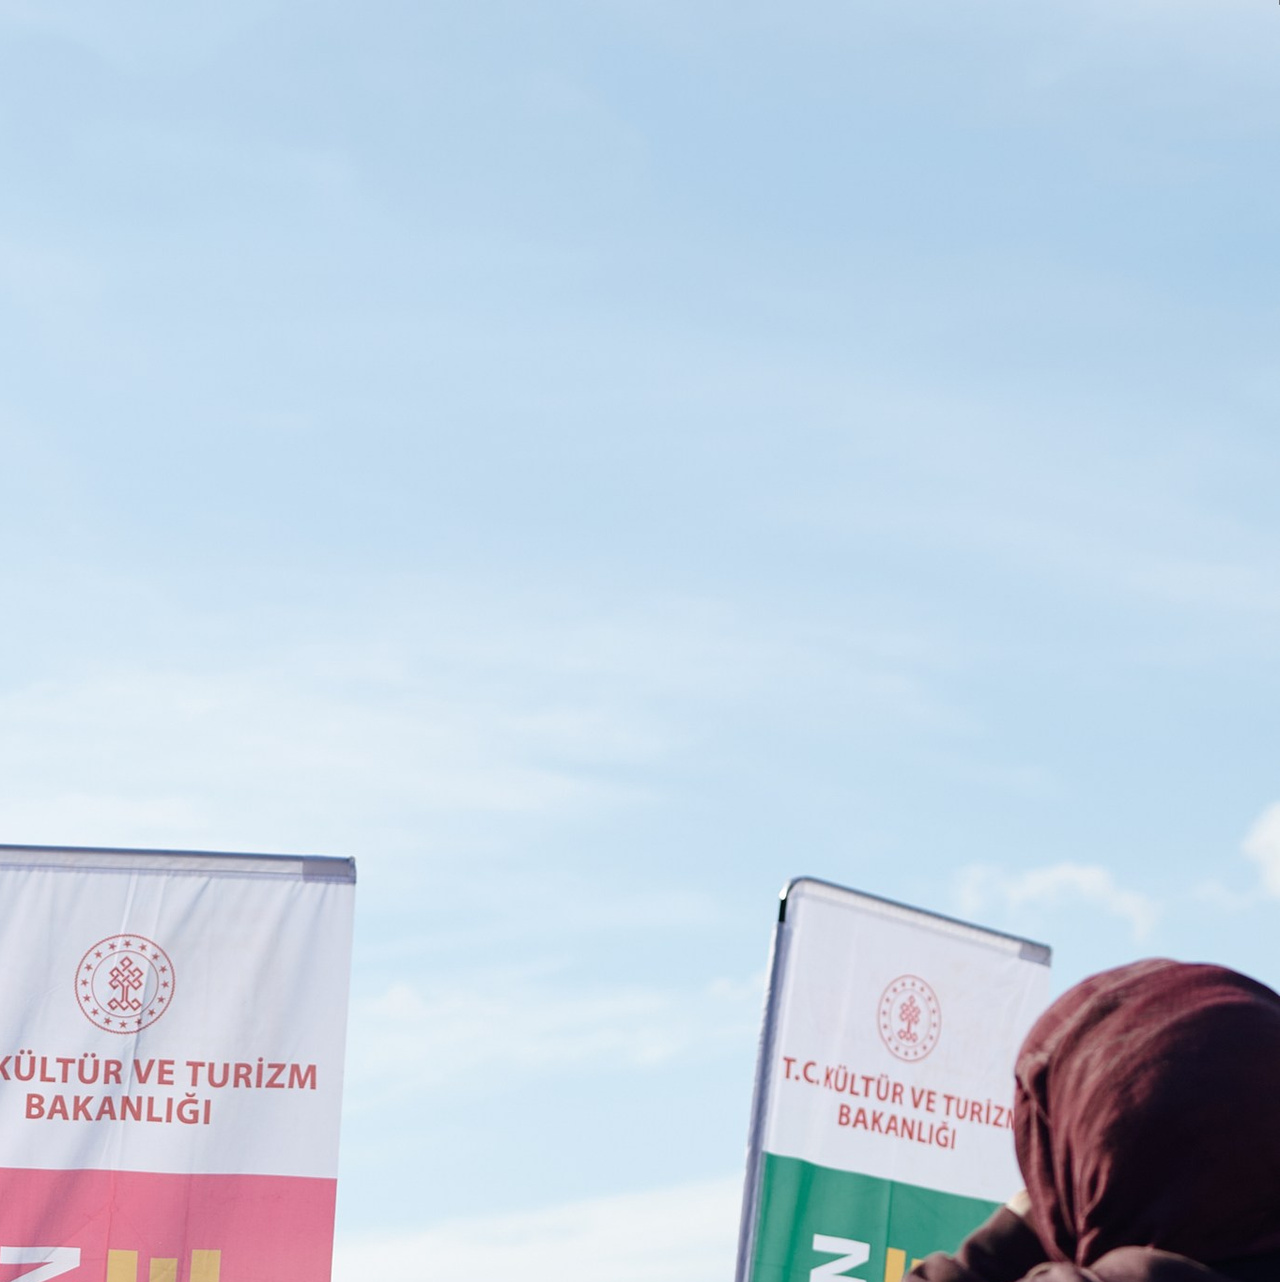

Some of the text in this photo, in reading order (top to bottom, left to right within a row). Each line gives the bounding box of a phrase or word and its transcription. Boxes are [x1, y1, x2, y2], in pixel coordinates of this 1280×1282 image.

[133, 1058, 175, 1086] VE
[186, 1057, 318, 1090] TURİZM
[783, 1056, 820, 1085] T.C.
[823, 1065, 905, 1106] KÜLTÜR
[911, 1086, 937, 1113] VE
[24, 1092, 212, 1126] BAKANLIĞI
[838, 1103, 957, 1150] BAKANLIĞI
